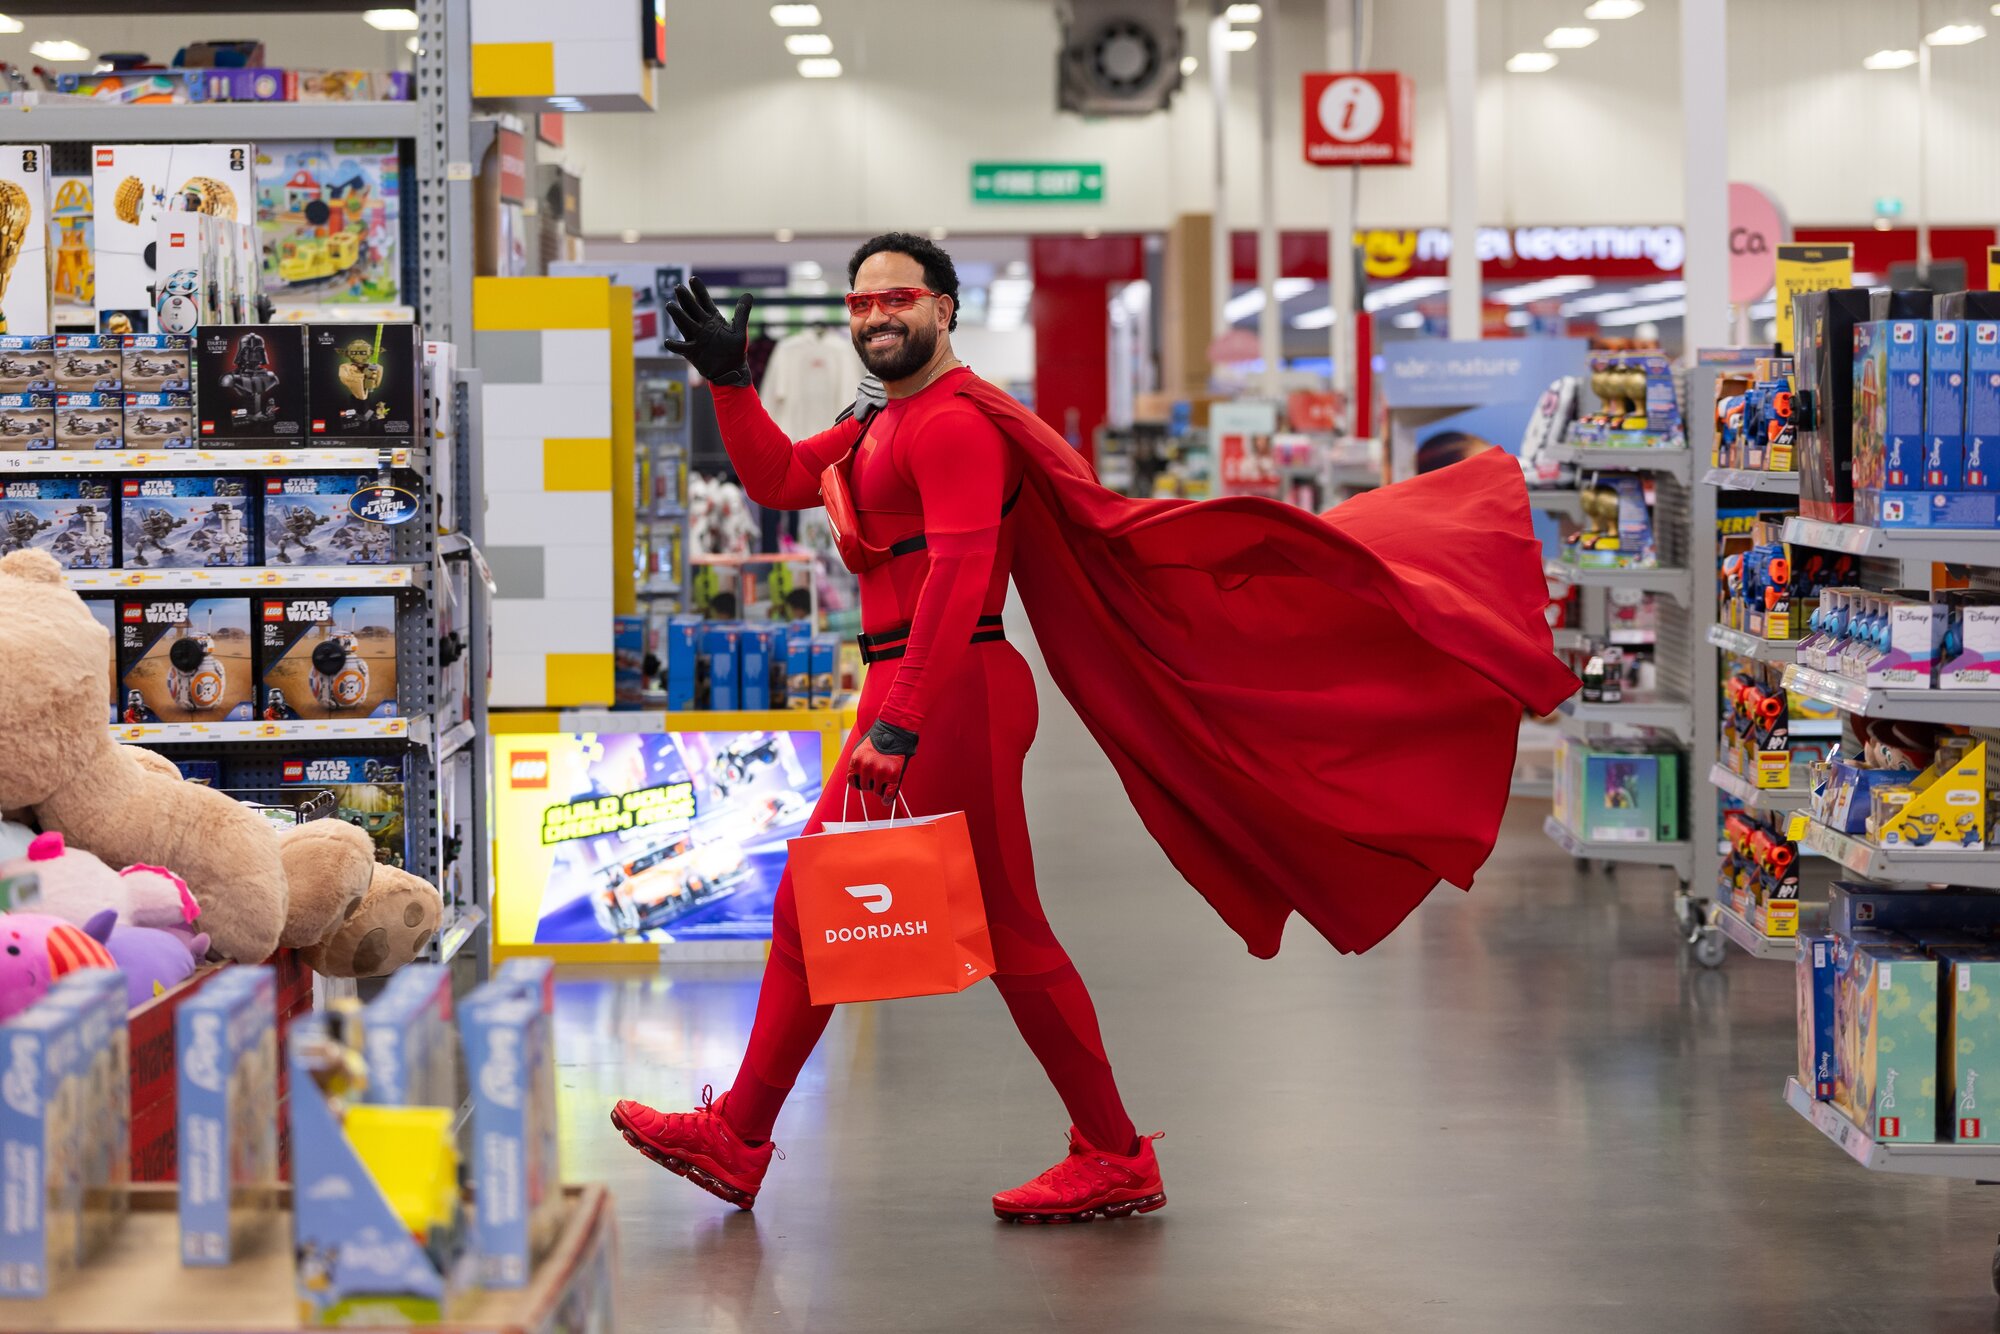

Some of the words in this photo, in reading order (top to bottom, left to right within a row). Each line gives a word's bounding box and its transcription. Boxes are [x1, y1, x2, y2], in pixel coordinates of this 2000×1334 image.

[1308, 144, 1394, 160] information
[1730, 227, 1769, 255] Co.
[141, 480, 175, 488] STAR
[284, 485, 318, 493] WARS
[6, 490, 39, 498] WARS
[141, 488, 175, 496] WARS
[360, 501, 406, 516] PLAYFUL
[378, 510, 398, 520] SIDE
[145, 603, 188, 612] STAR
[286, 601, 331, 611] STAR
[145, 612, 188, 623] WARS
[286, 611, 331, 621] WARS
[1896, 609, 1929, 624] Disney
[1966, 610, 2000, 624] Disney
[306, 760, 351, 770] STAR
[511, 758, 548, 782] LEGO
[306, 770, 351, 781] WARS
[546, 796, 620, 825] BUILD
[622, 782, 693, 811] YOUR
[543, 811, 633, 843] DREAM
[635, 798, 696, 826] RIDE
[825, 920, 928, 944] DOORDASH
[1817, 1051, 1831, 1082] Disney
[1879, 1067, 1900, 1113] Disney
[1959, 1068, 1980, 1112] Disney
